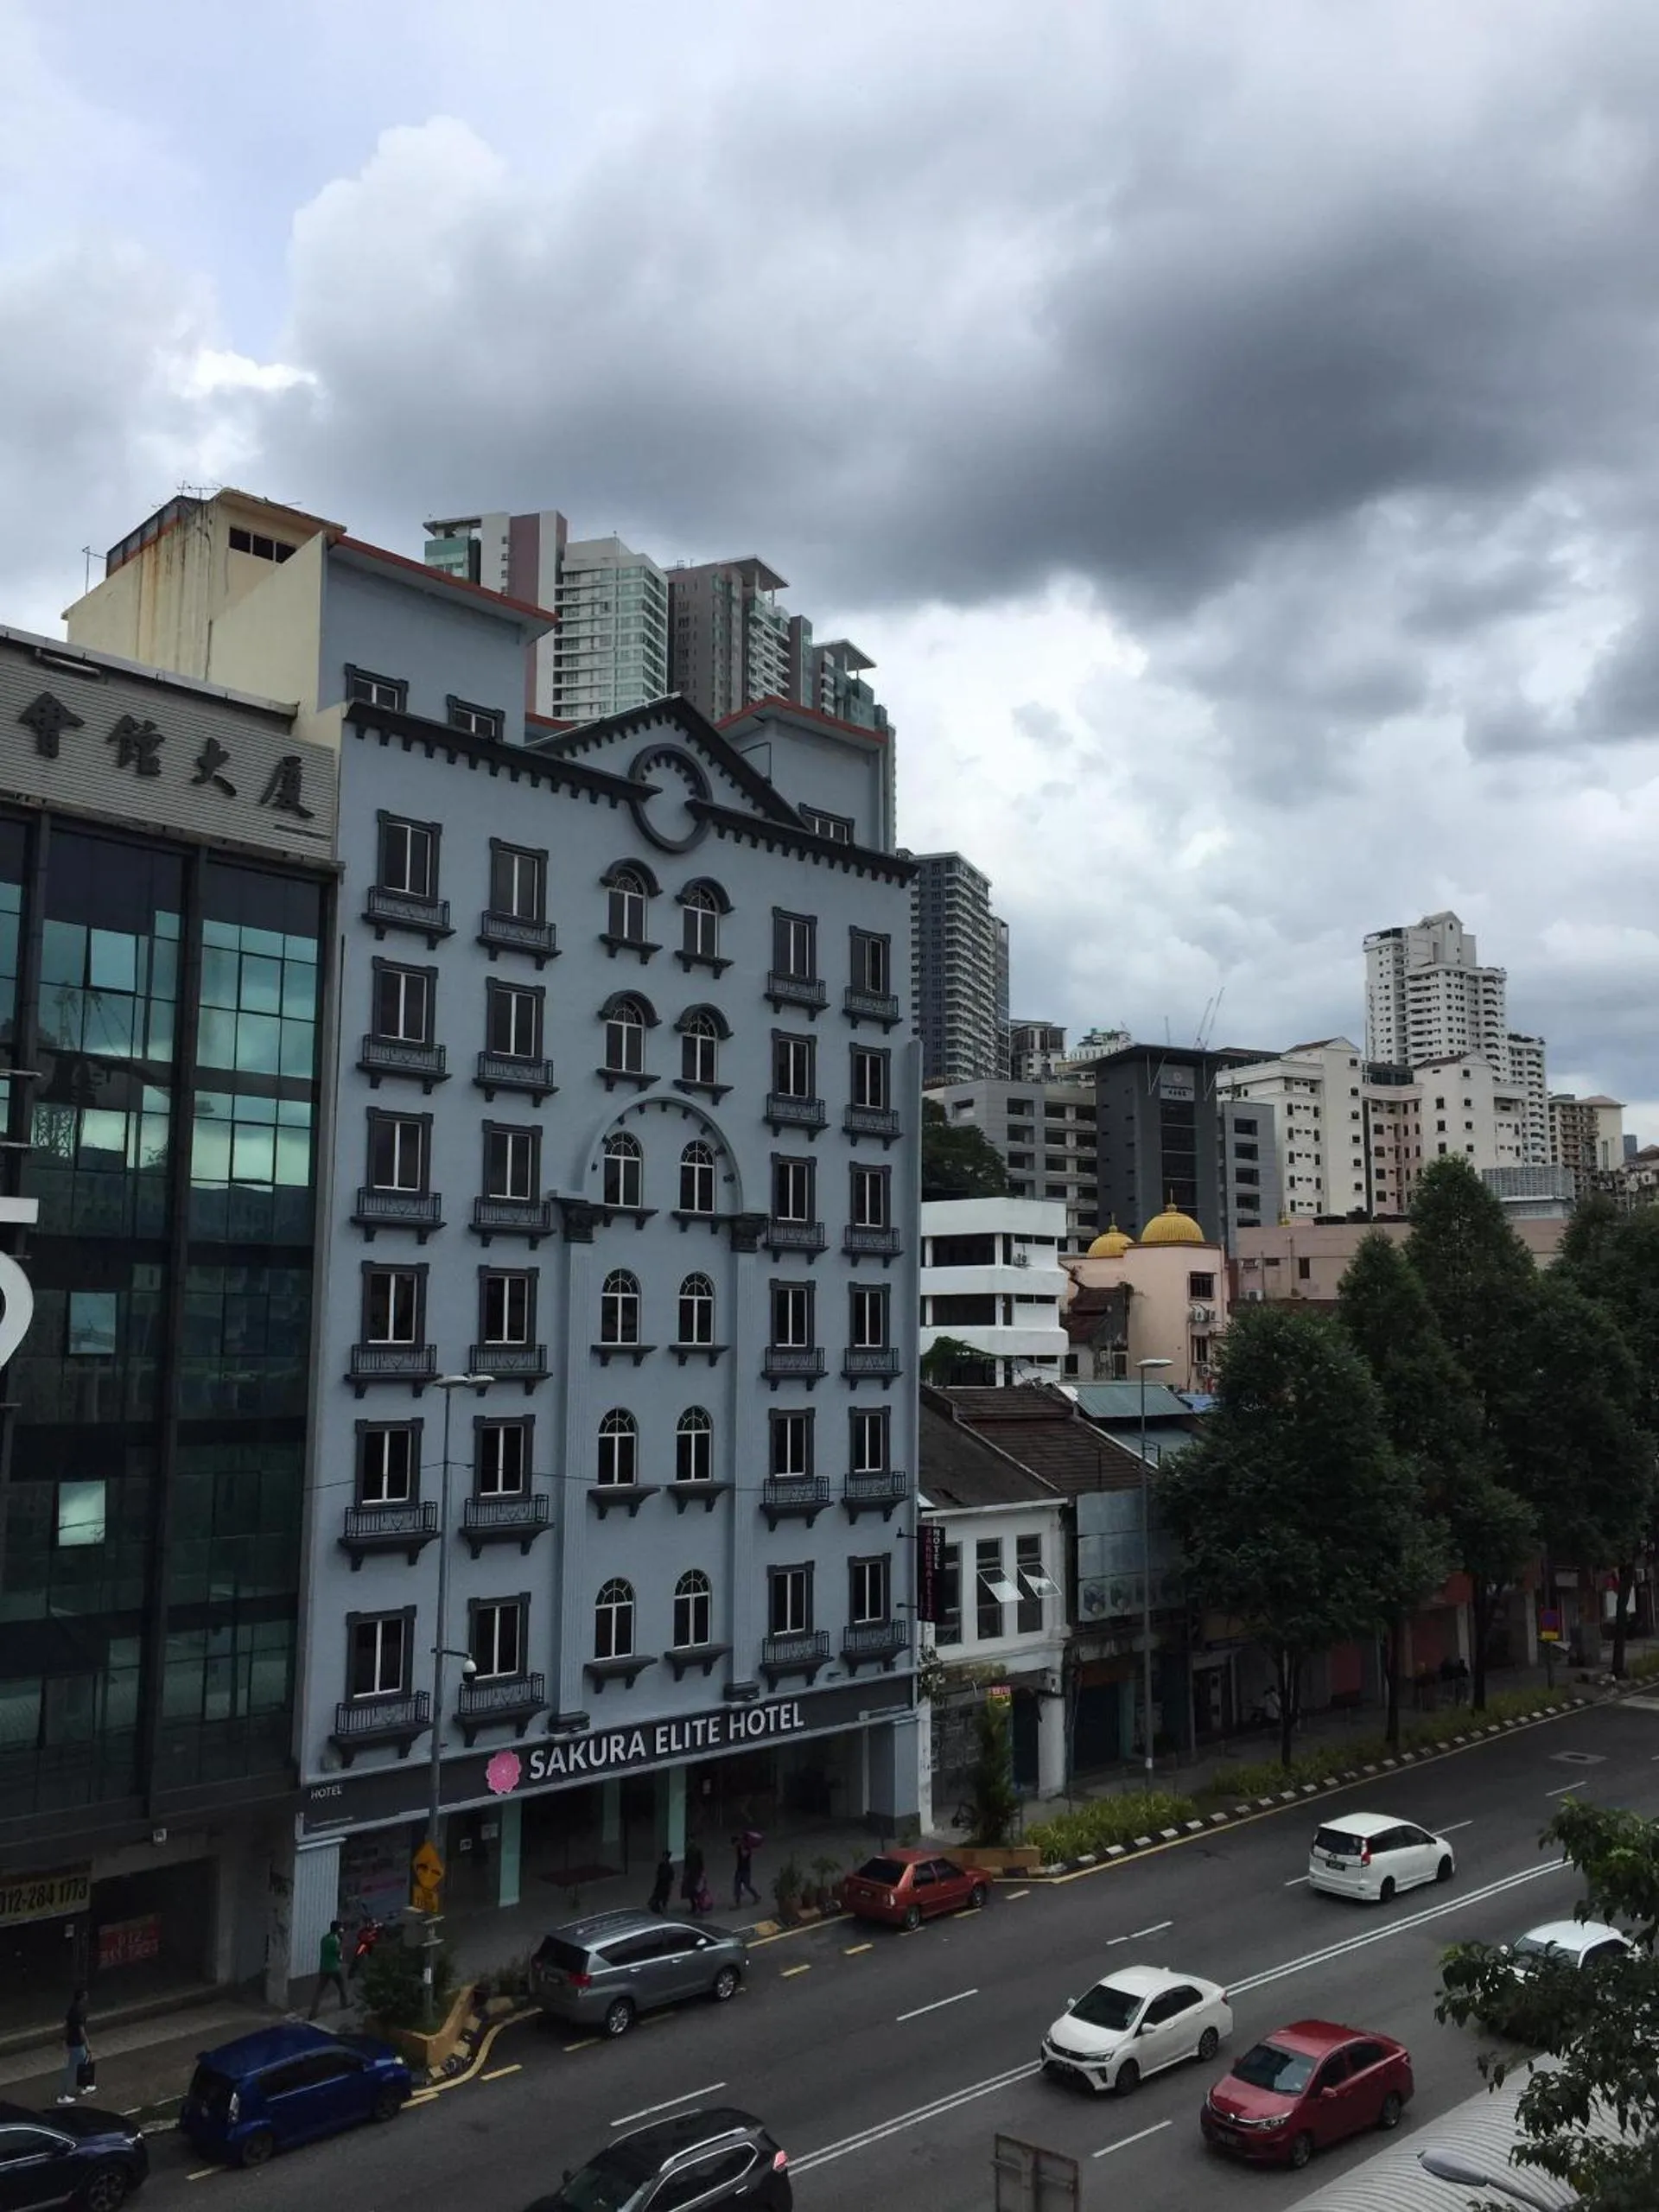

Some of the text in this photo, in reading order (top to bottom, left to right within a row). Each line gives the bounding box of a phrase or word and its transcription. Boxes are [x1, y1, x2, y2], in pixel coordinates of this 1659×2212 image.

[932, 1529, 941, 1570] HOTEL
[530, 1701, 805, 1780] SAKURA ELITE HOTEL
[310, 1783, 343, 1800] HOTEL
